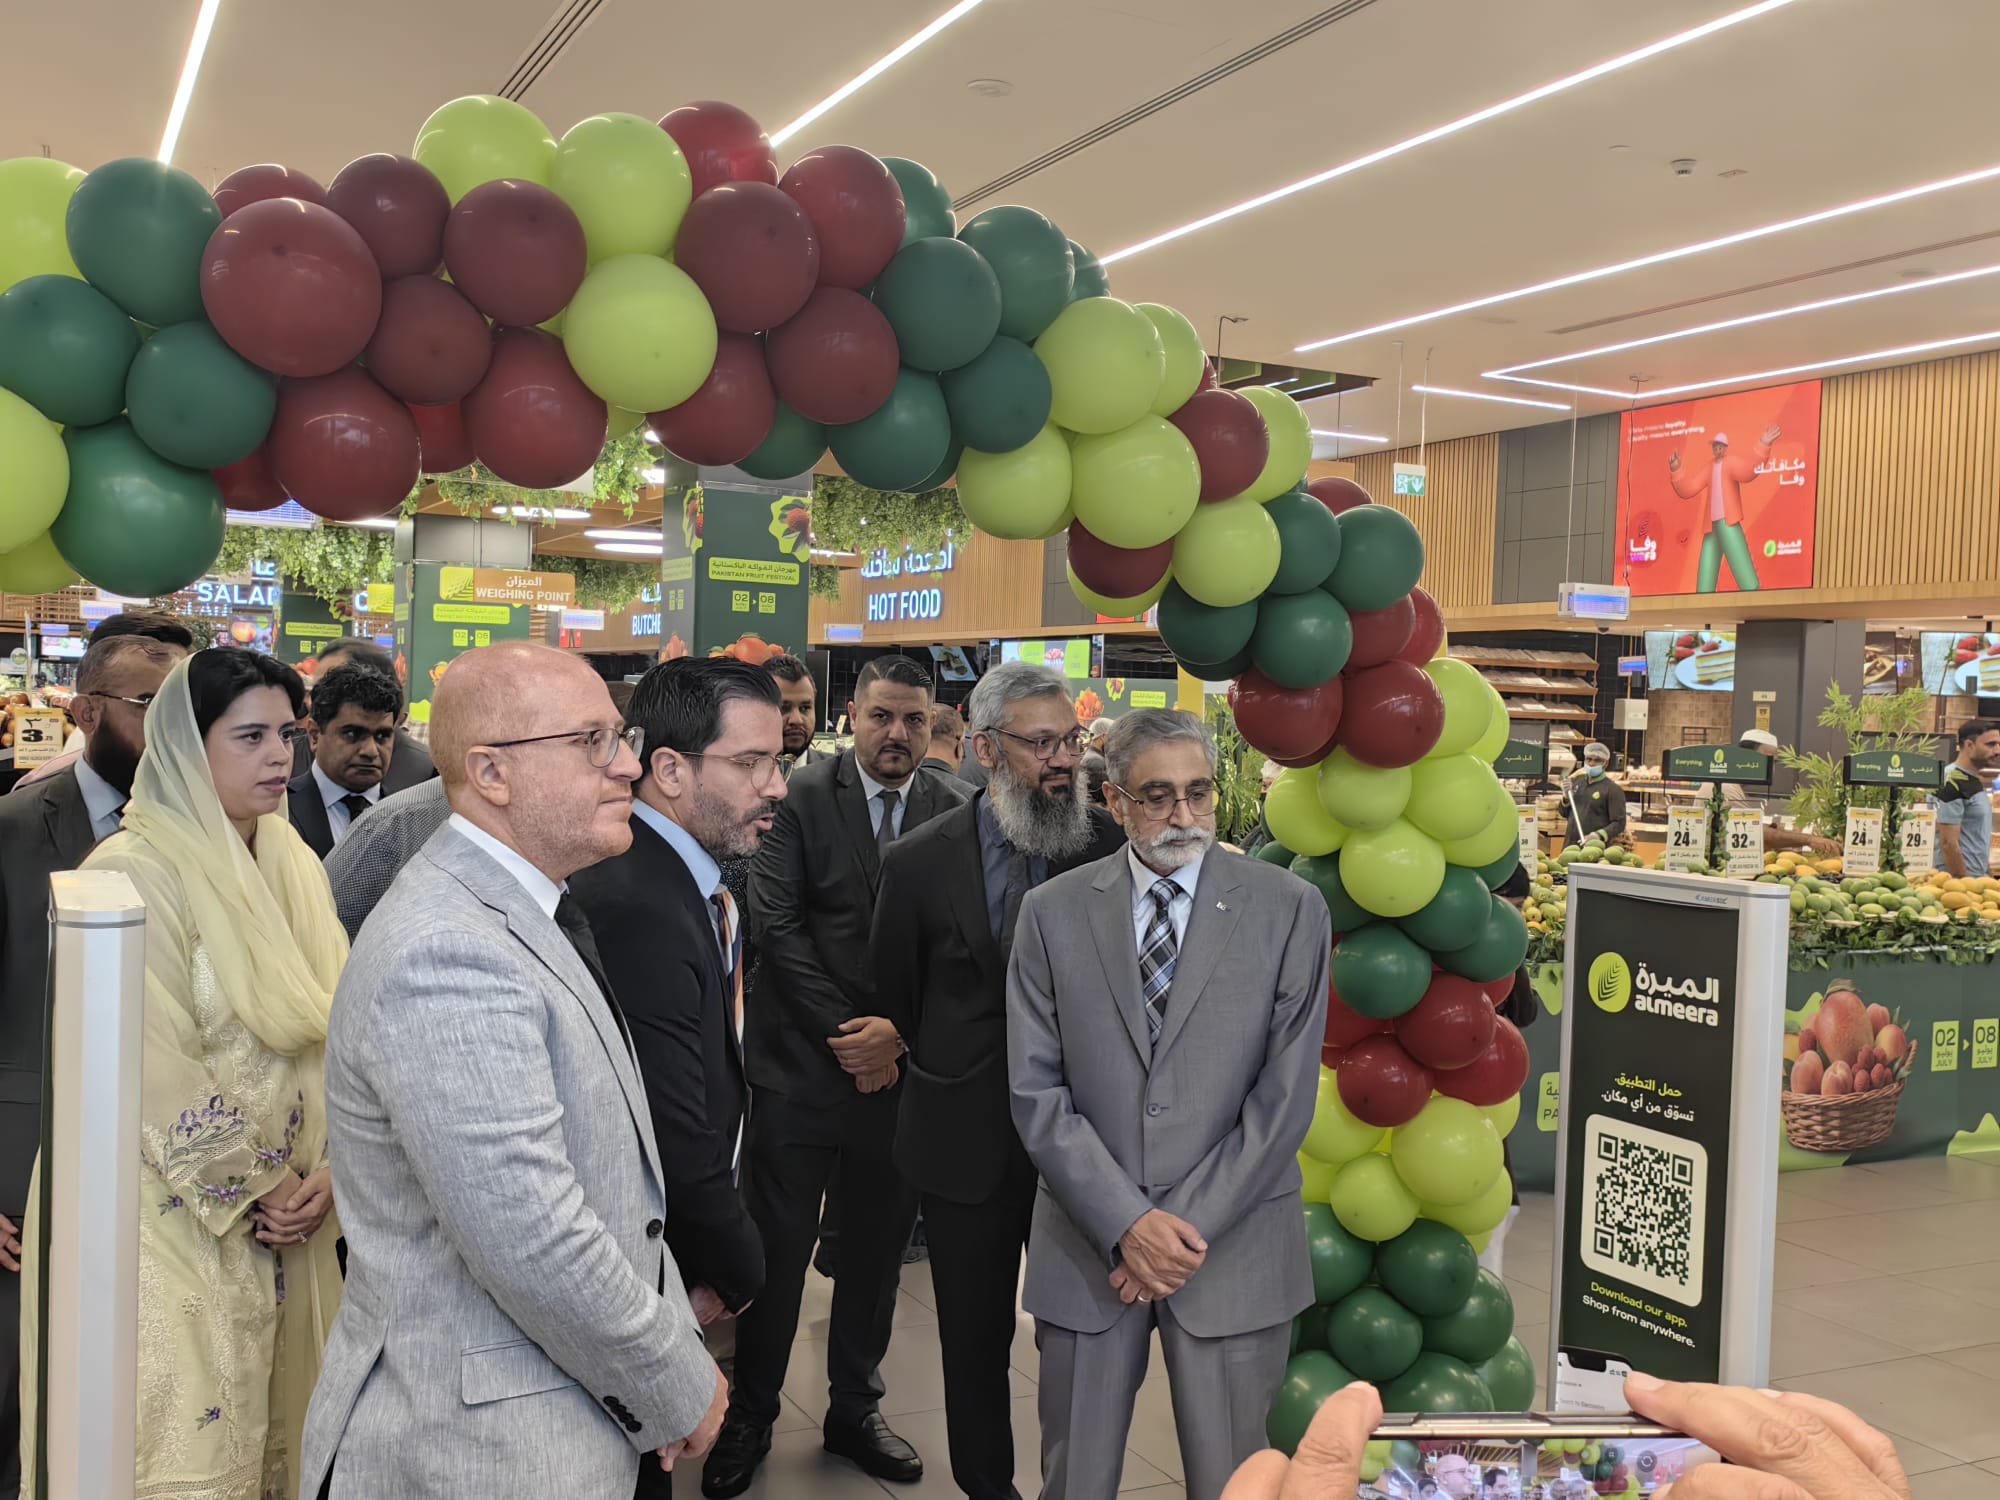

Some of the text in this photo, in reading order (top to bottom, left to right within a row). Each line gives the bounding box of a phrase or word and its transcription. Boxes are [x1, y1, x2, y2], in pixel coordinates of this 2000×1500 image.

[1780, 471, 1805, 486] وفا
[506, 576, 542, 588] الميزان
[476, 587, 571, 602] WEIGHING POINT
[869, 588, 941, 621] HOT FOOD
[22, 729, 43, 742] 3
[1674, 831, 1690, 846] 24
[1732, 834, 1748, 848] 32
[1852, 831, 1866, 846] 24
[1907, 833, 1921, 847] 29
[1636, 962, 1719, 1003] الميرة
[1635, 994, 1718, 1026] almeera
[1936, 1028, 1956, 1046] 02
[1976, 1026, 1996, 1044] 08
[1658, 1083, 1682, 1097] حمل
[1630, 1093, 1643, 1112] أي
[1646, 1102, 1661, 1114] من
[1591, 1282, 1688, 1327] Download our app.
[1582, 1294, 1696, 1348] Shop from anywhere.
